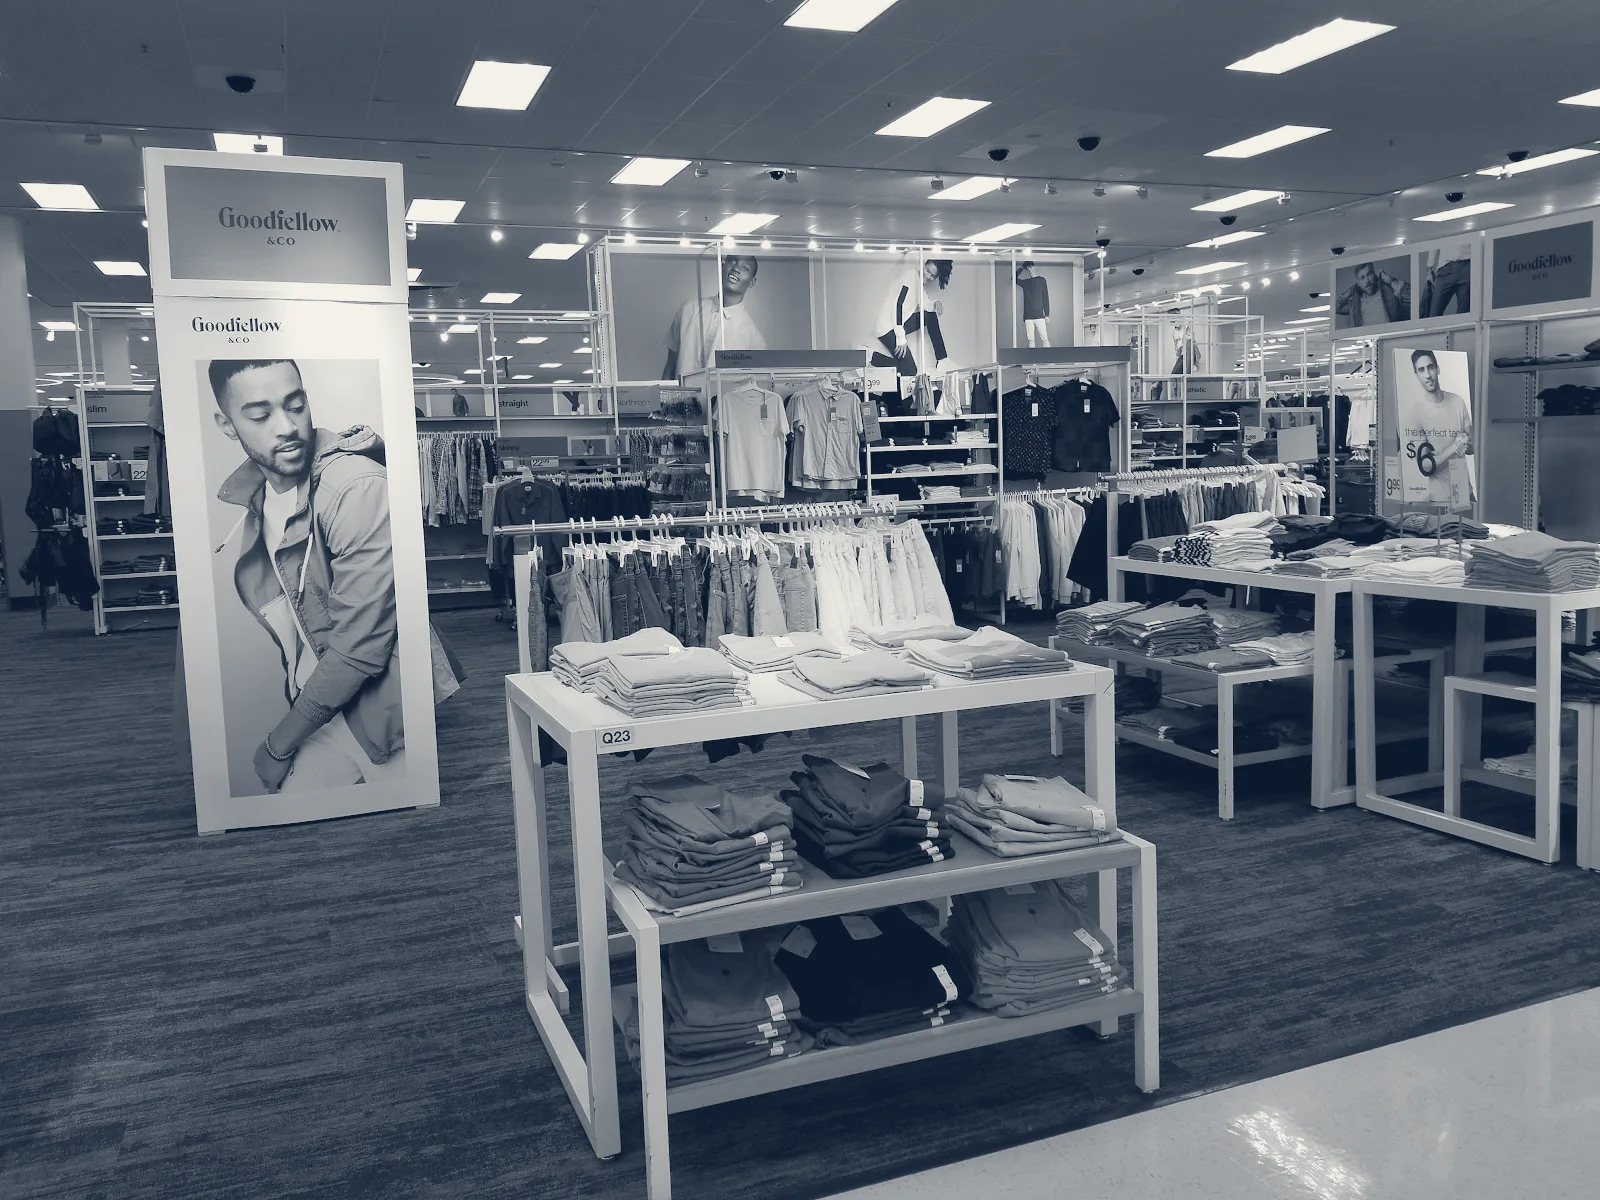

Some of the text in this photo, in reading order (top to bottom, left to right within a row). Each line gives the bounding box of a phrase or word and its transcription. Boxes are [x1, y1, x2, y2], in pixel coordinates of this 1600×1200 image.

[218, 205, 339, 232] Goodfellow
[1508, 252, 1574, 275] Goodfellow
[191, 316, 283, 333] Goodfellow
[87, 404, 108, 413] slim
[498, 399, 529, 409] straight
[1404, 427, 1418, 437] the
[1419, 427, 1448, 439] perfect
[498, 444, 521, 452] skinny
[1406, 440, 1437, 478] $6
[133, 470, 147, 480] 22
[602, 729, 631, 745] Q23
